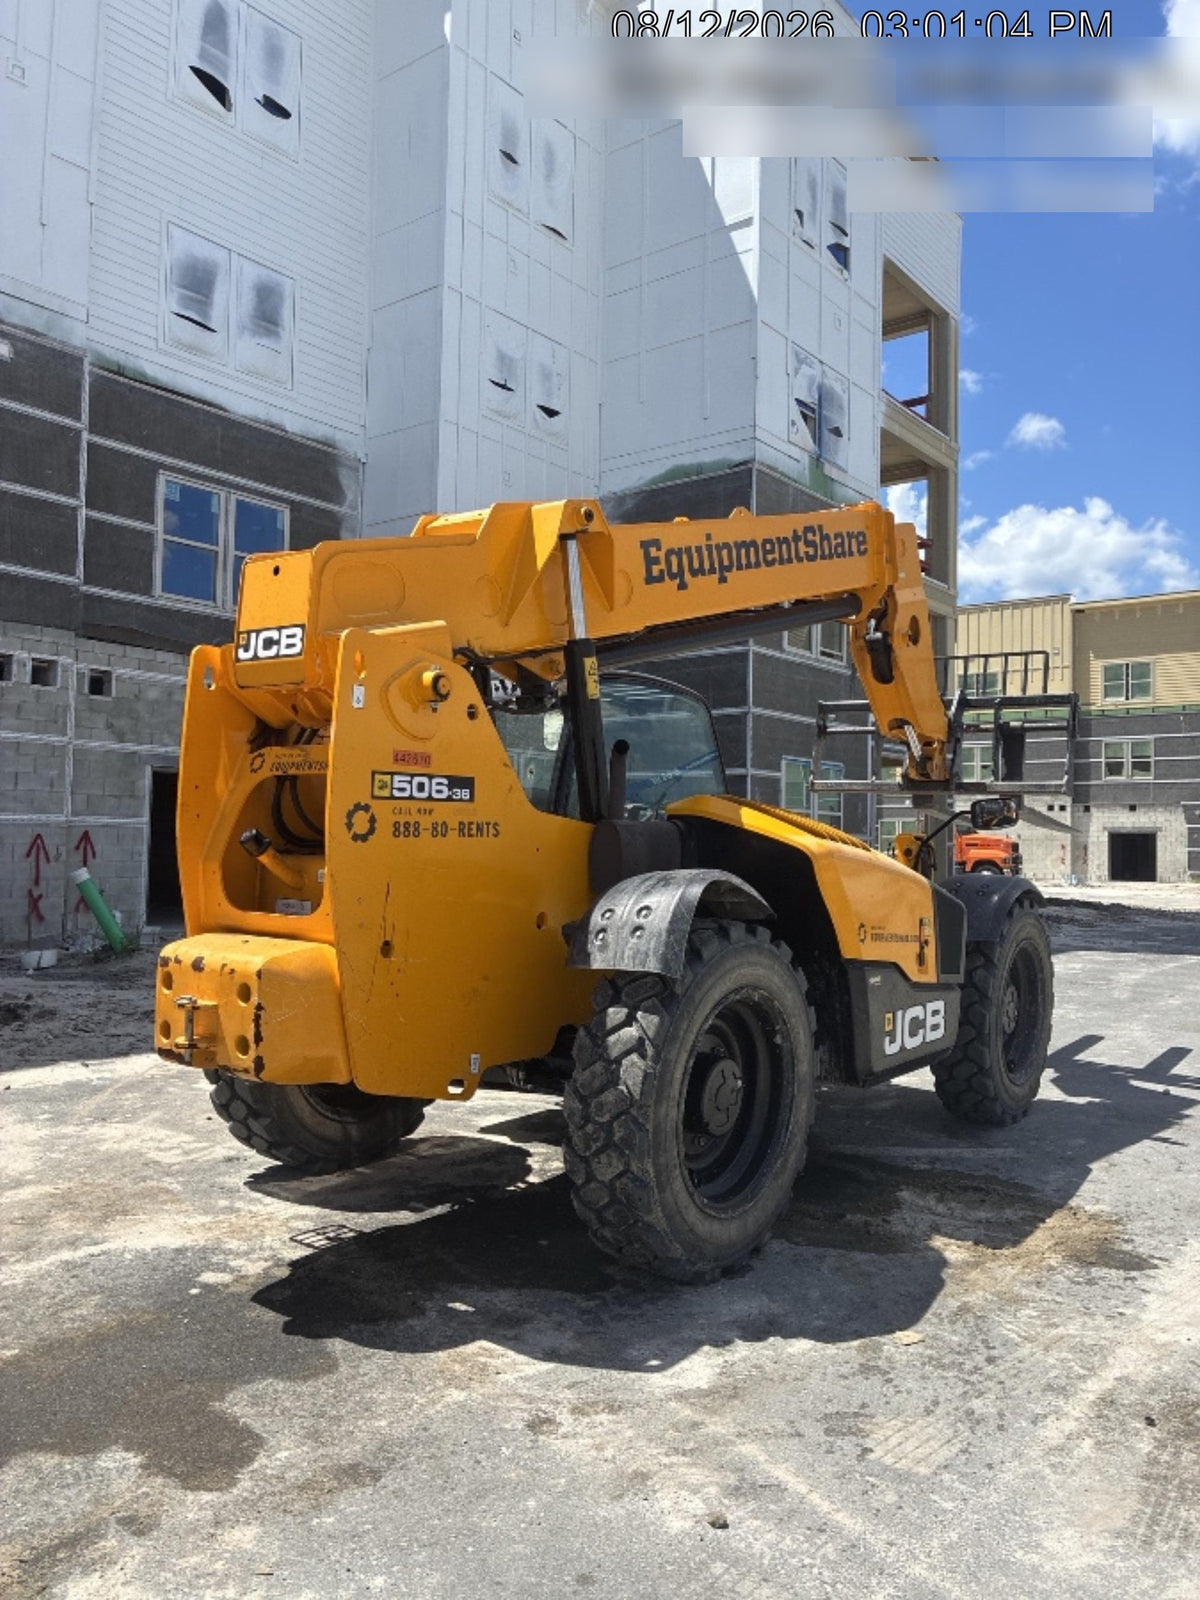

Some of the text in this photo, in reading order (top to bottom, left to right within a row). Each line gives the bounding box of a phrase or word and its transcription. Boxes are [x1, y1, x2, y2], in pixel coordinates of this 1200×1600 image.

[639, 524, 868, 591] EquipmentShare
[237, 627, 303, 660] JCB
[392, 821, 500, 838] 888-80-RENTS
[884, 1000, 945, 1055] JCB
